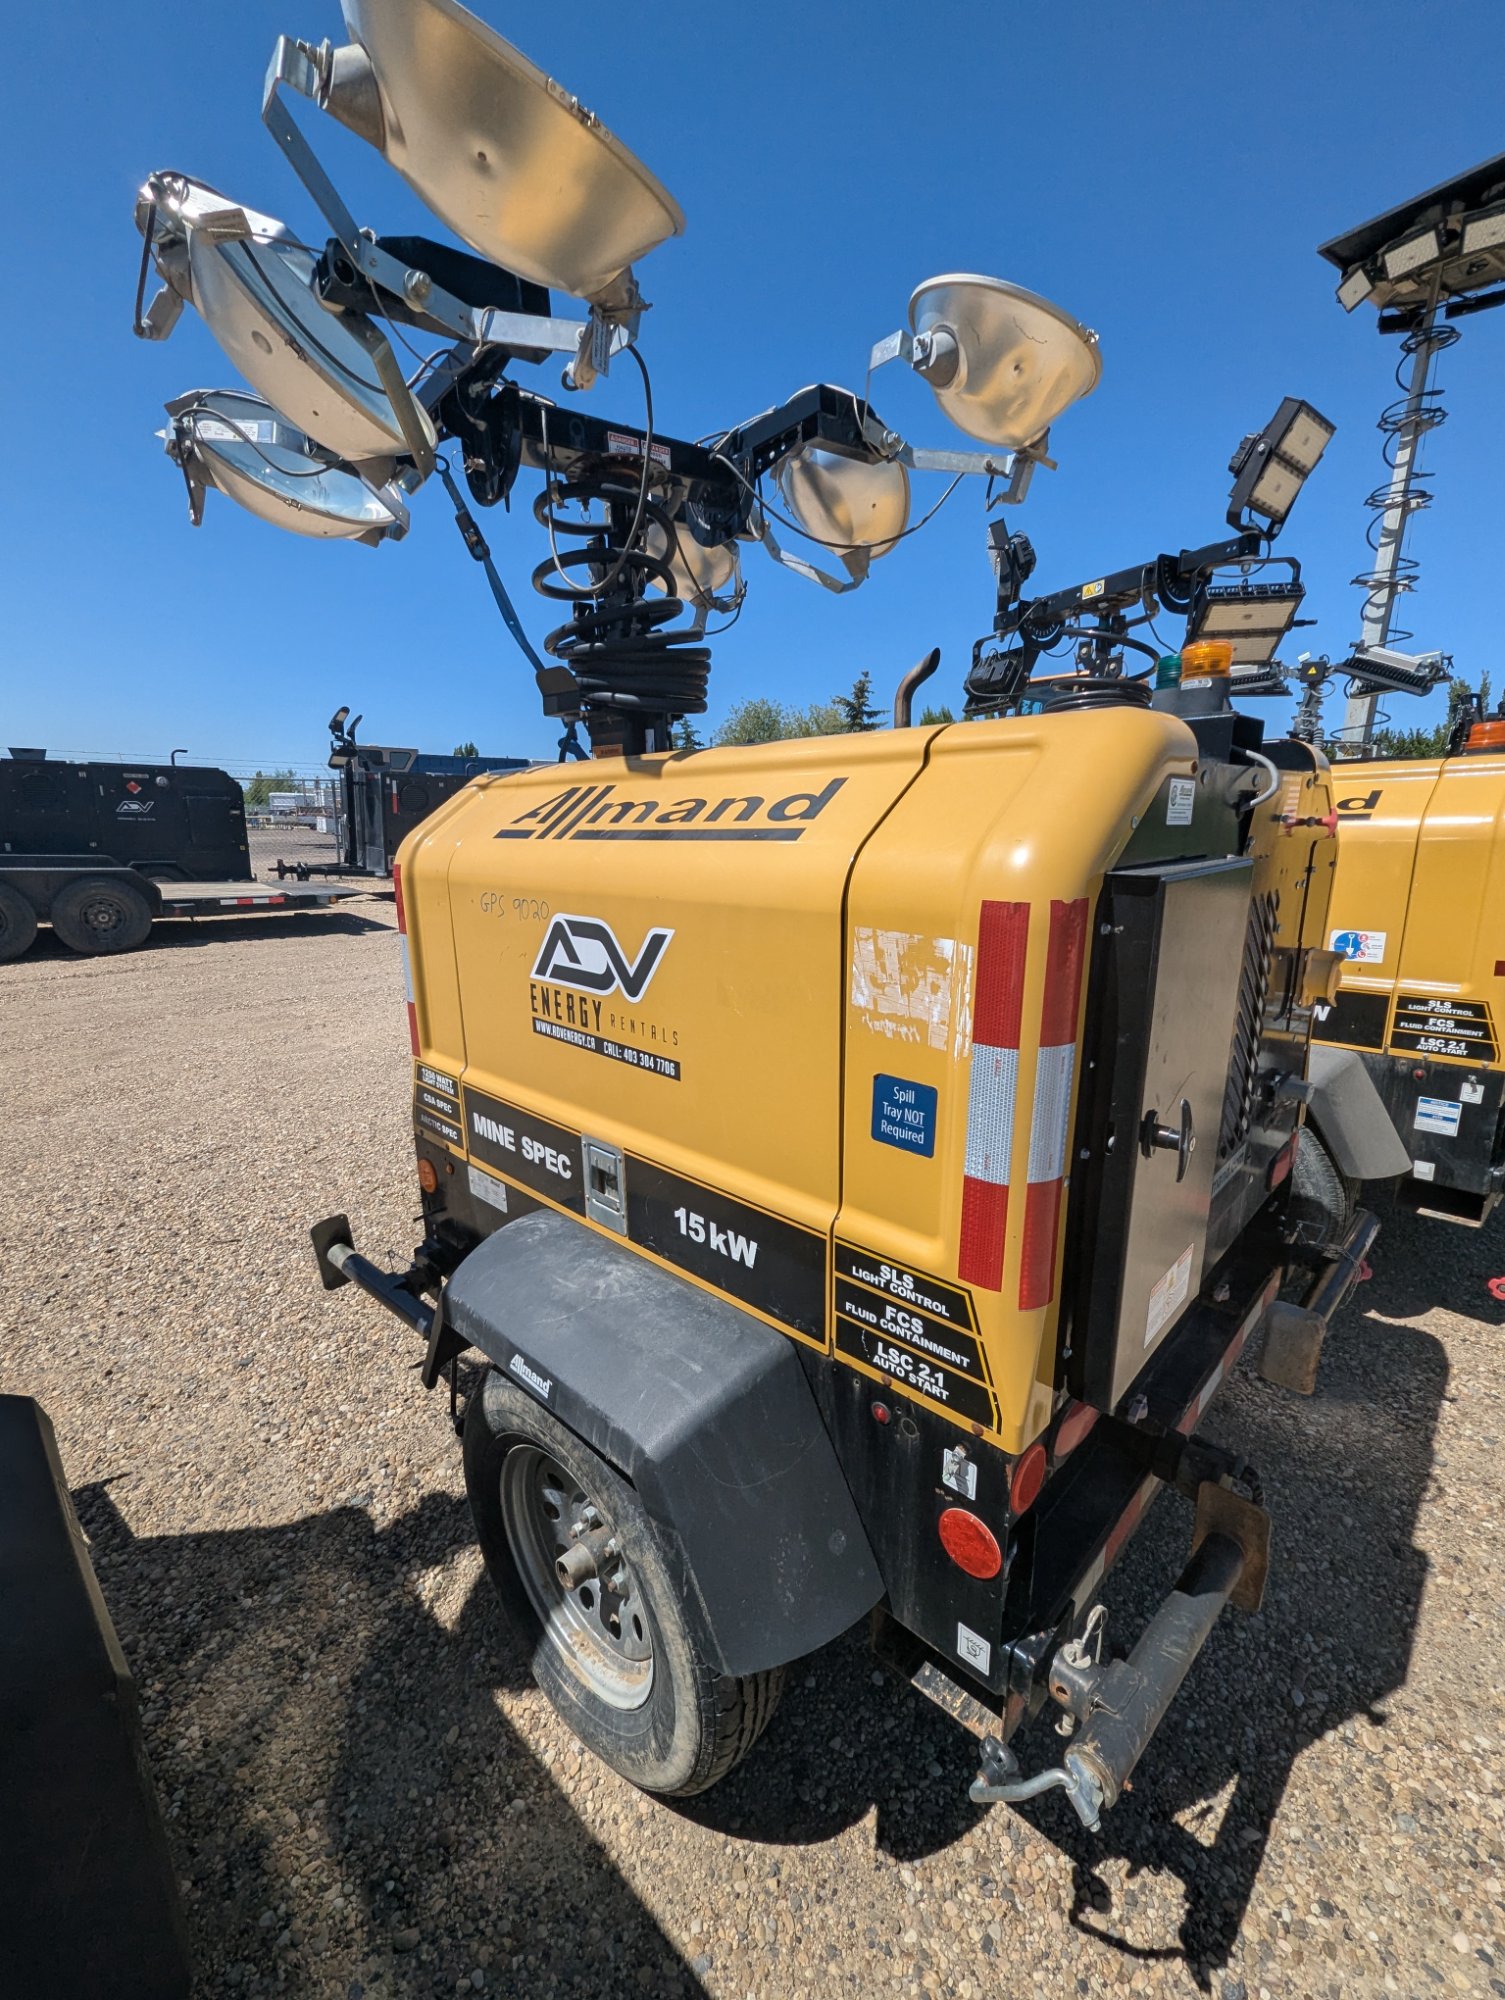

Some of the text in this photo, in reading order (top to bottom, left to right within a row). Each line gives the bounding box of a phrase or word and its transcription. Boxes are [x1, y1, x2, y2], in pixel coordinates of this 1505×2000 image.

[510, 777, 849, 840] Allmand
[480, 891, 550, 921] GPS 9020
[531, 915, 673, 1001] ADV
[530, 983, 679, 1046] ENERGY RENTALS
[1408, 1004, 1474, 1017] LIGHT CONTROL
[1428, 1000, 1452, 1009] SLS
[1424, 1025, 1484, 1037] CONTAINMENT
[1428, 1018, 1455, 1028] FCS
[535, 1019, 676, 1076] WWW.ADVENERGY.CA CALL: 403 304 7706
[1416, 1044, 1468, 1056] AUTO START
[1420, 1037, 1467, 1050] LSC 2.1
[436, 1072, 453, 1087] WATT
[436, 1099, 453, 1113] SPEC
[893, 1086, 915, 1104] Spill
[421, 1113, 458, 1140] ARCTIC SPEC
[882, 1101, 925, 1126] Tray NOT
[881, 1119, 924, 1144] Required
[473, 1112, 573, 1180] MINE SPEC
[674, 1206, 758, 1269] 15 kW
[852, 1266, 950, 1317] LIGHT CONTROL
[880, 1265, 914, 1290] SLS
[885, 1305, 924, 1335] FCS
[845, 1302, 970, 1368] FLUID CONTAINMENT
[510, 1353, 550, 1396] Allmand
[872, 1355, 949, 1400] AUTO START
[877, 1341, 944, 1388] LSC 2.1
